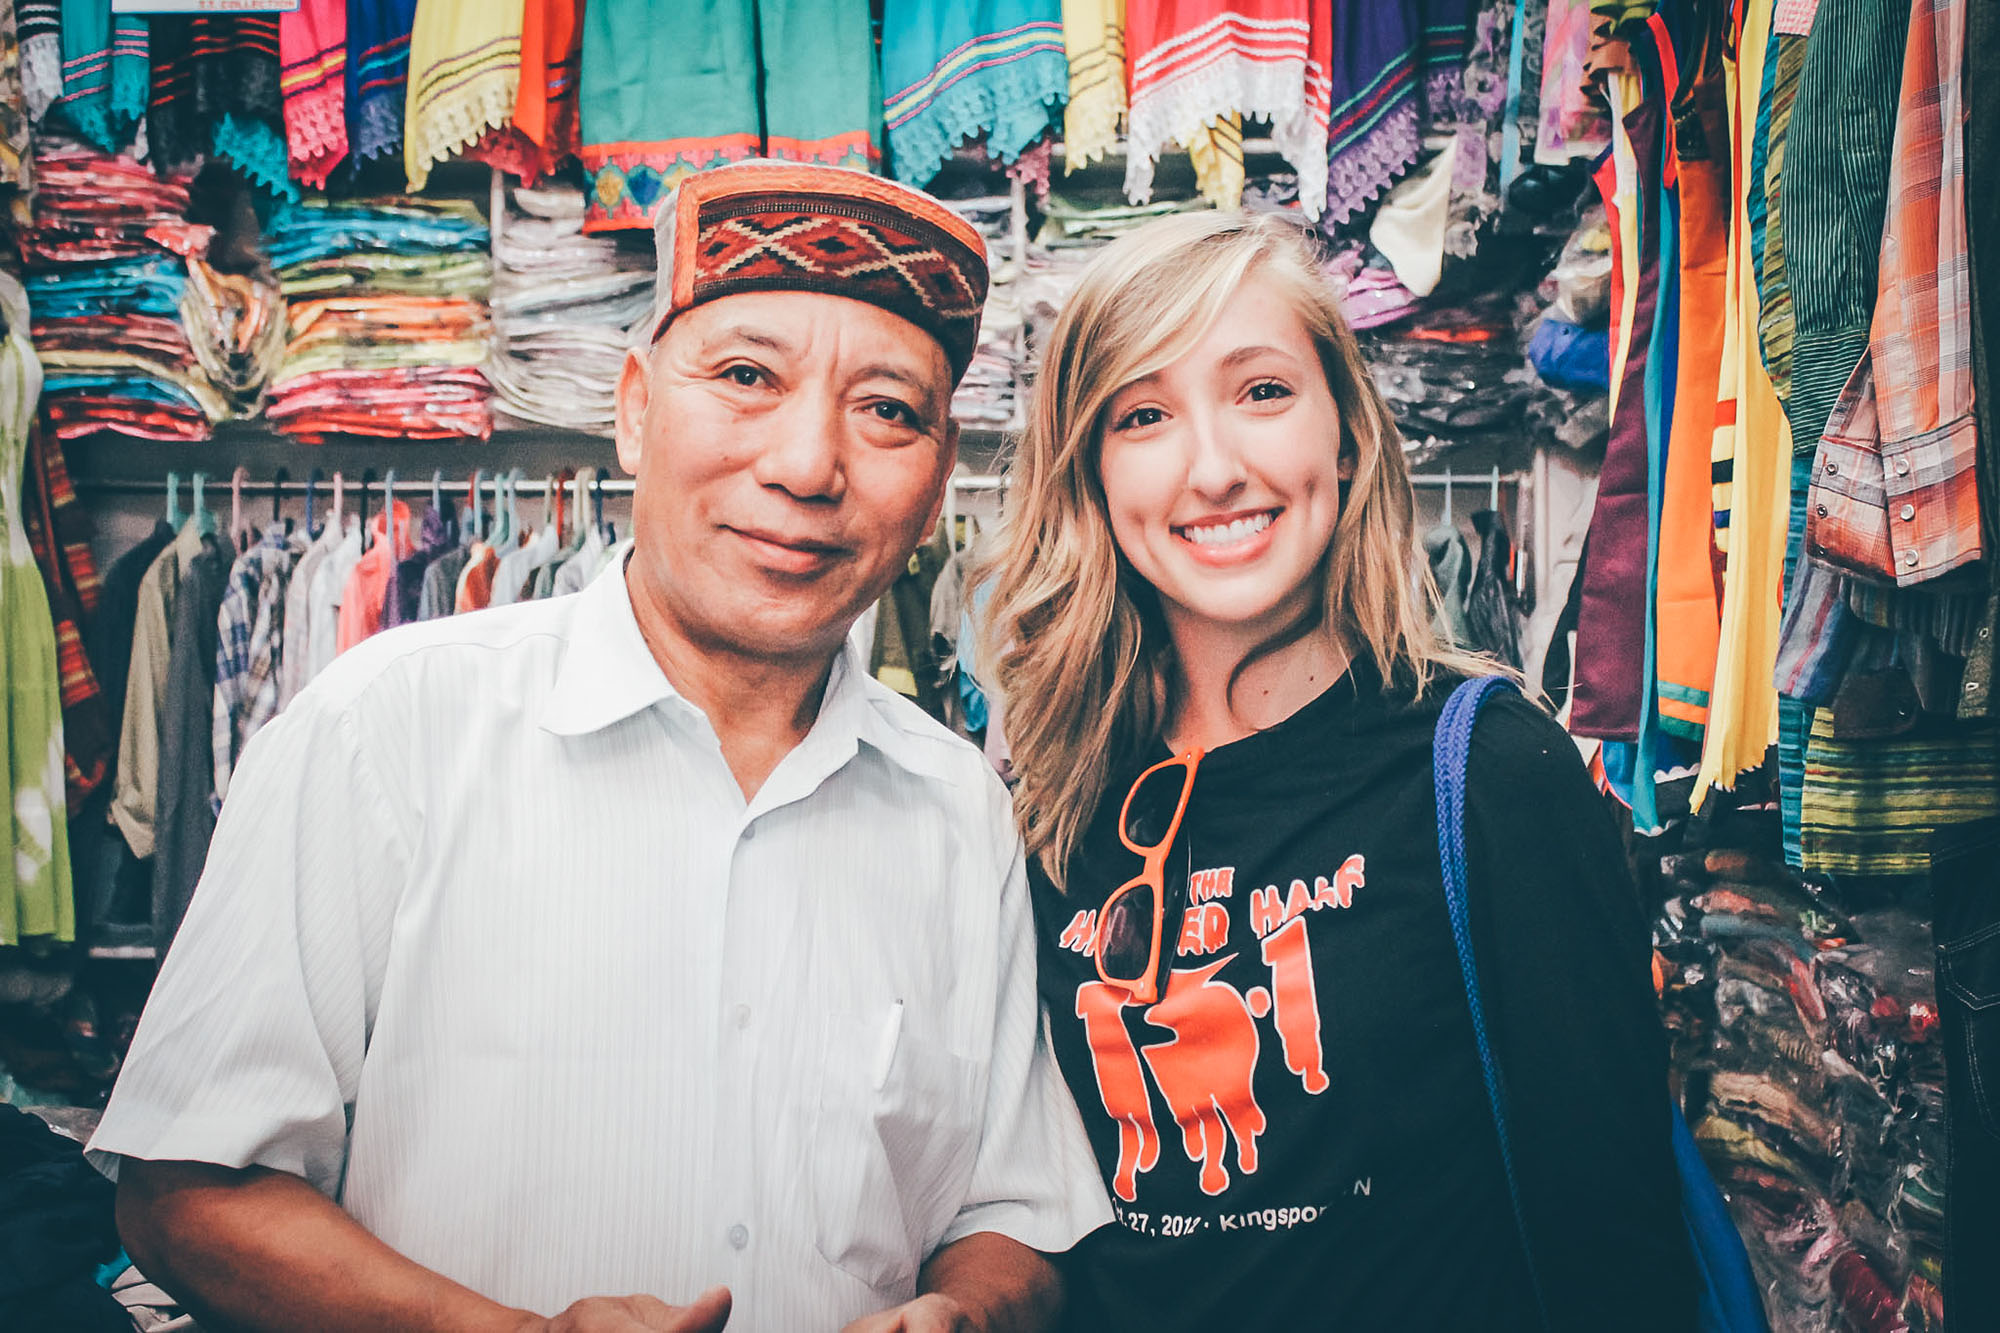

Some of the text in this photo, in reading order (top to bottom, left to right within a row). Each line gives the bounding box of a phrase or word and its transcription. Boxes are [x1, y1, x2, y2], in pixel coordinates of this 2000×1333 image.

[1250, 853, 1365, 940] HALF
[1128, 1211, 1155, 1237] 27,
[1219, 1205, 1328, 1232] Kingspor
